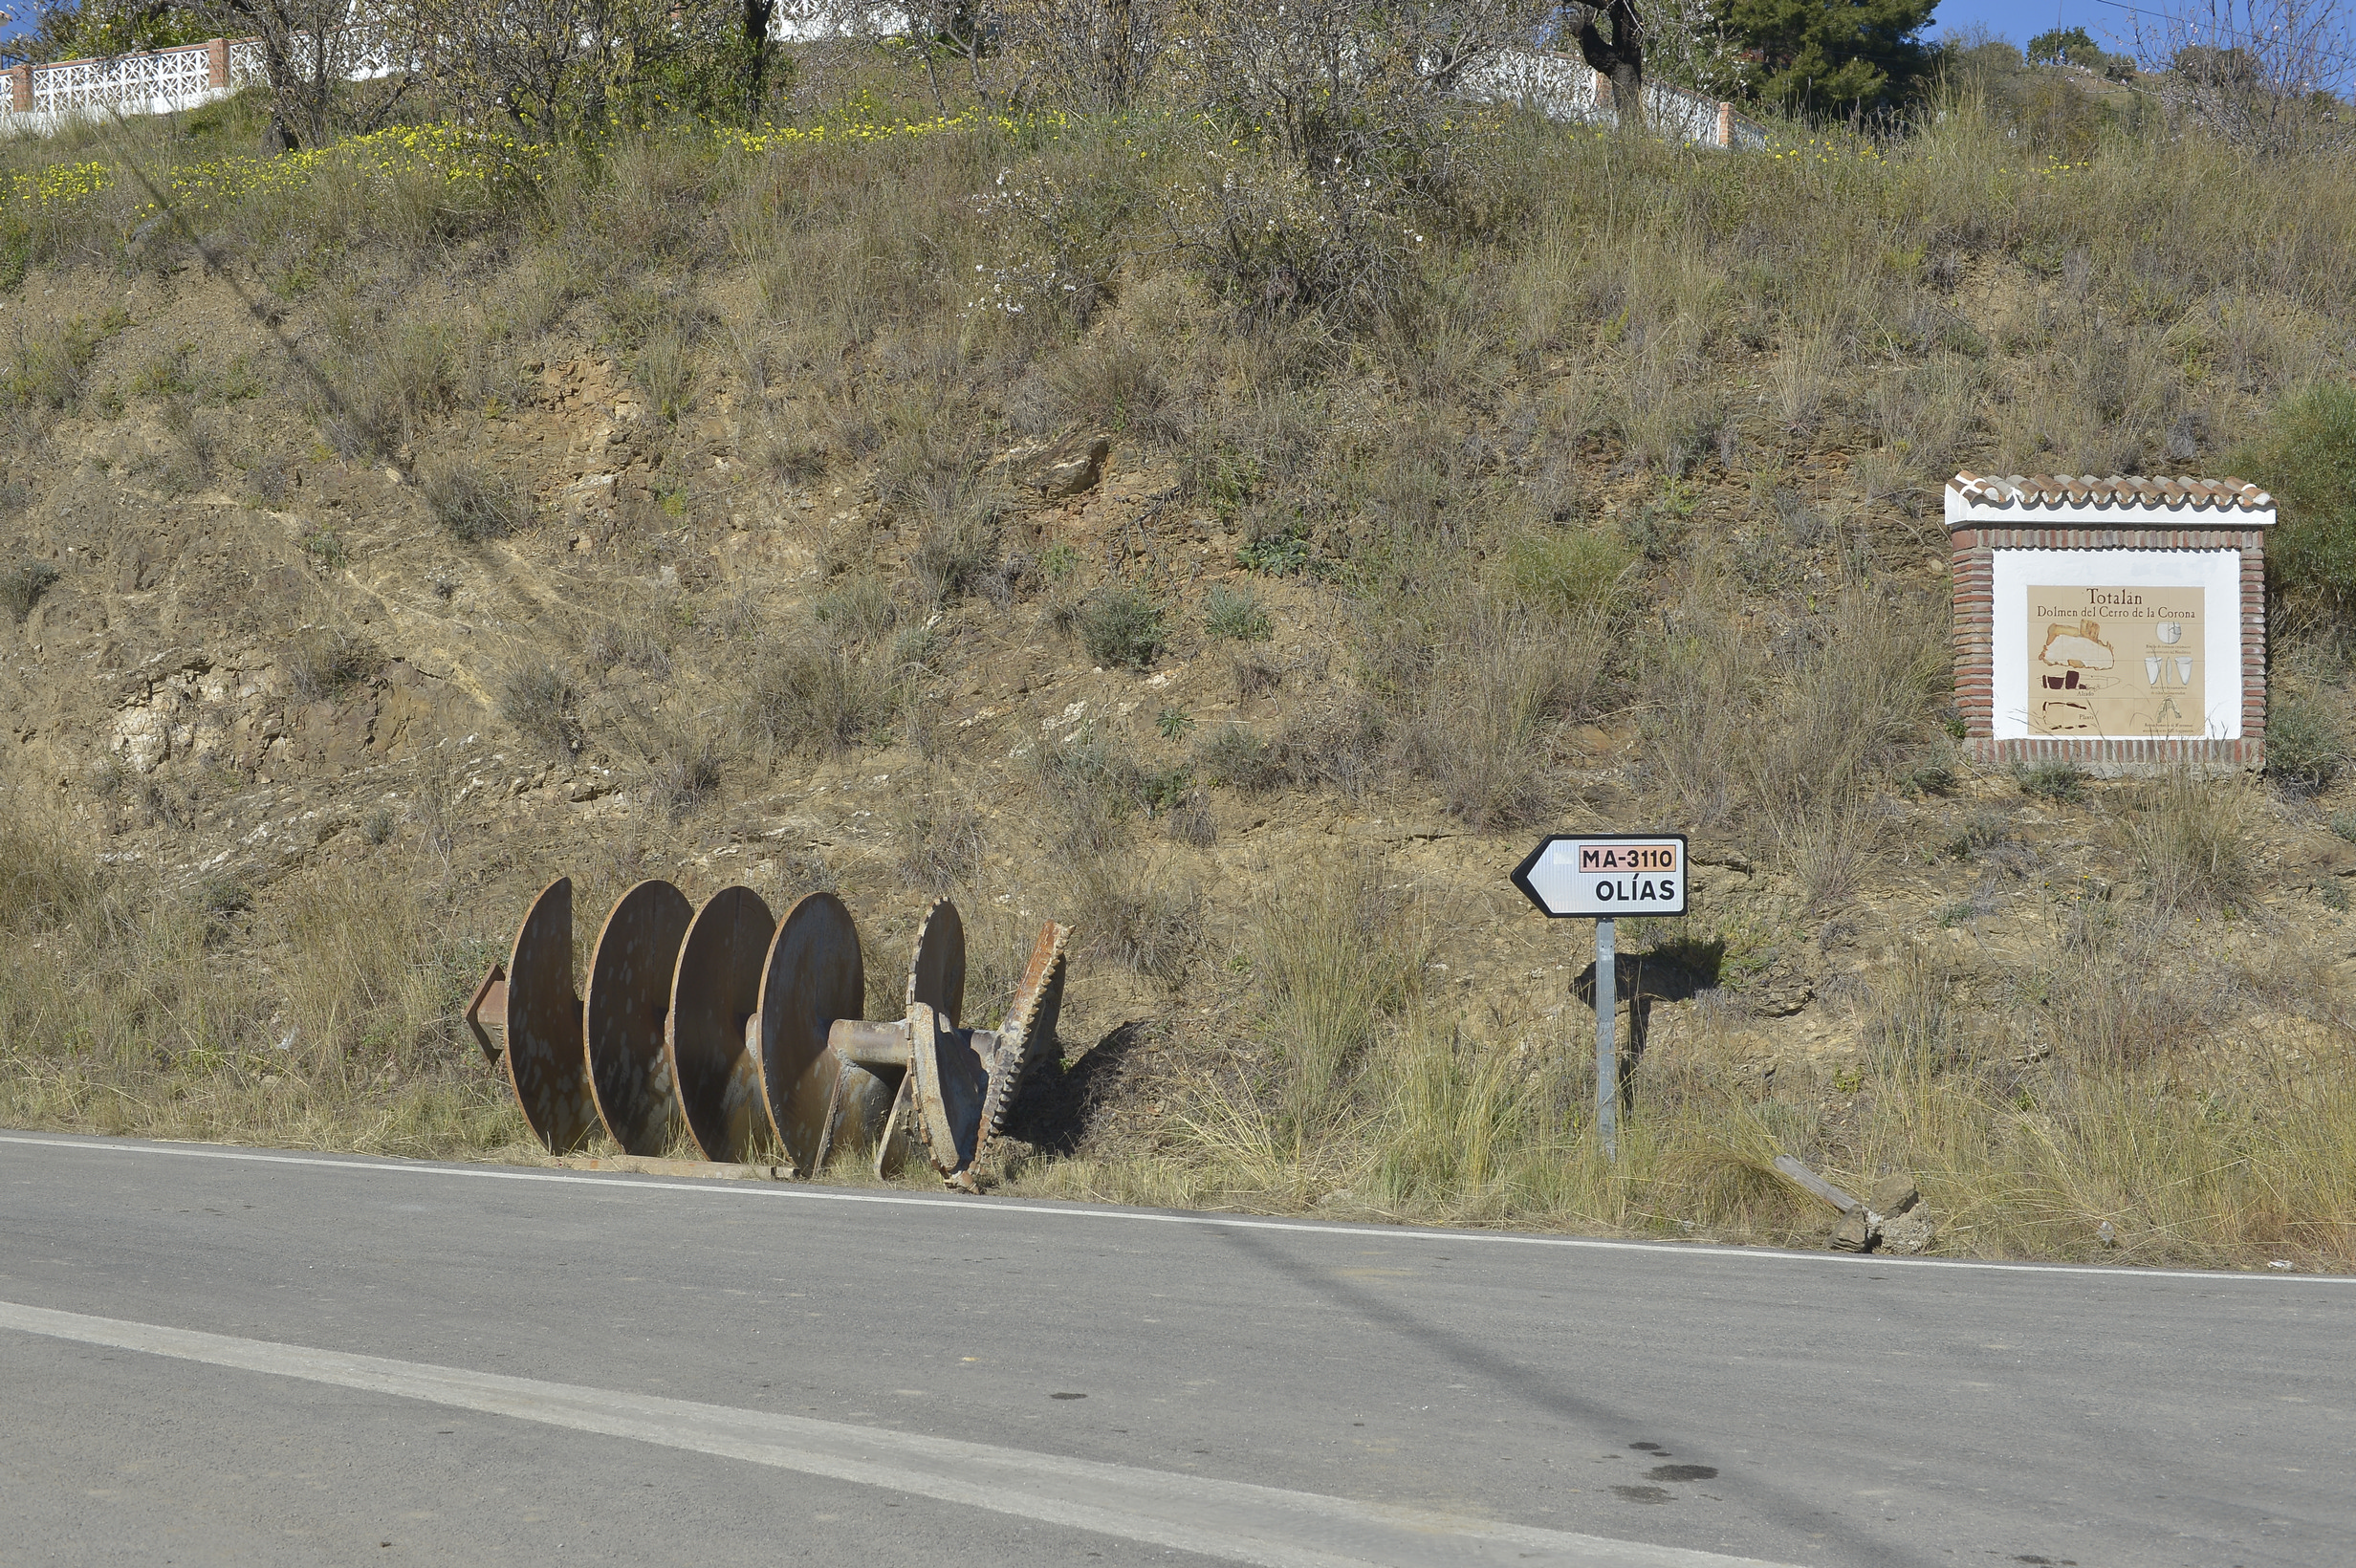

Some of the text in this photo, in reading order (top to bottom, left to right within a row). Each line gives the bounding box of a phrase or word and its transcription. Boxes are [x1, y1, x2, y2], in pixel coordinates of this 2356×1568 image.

[2086, 588, 2142, 605] Totalán
[2038, 606, 2195, 619] Dolmen del Cerro de la Corona
[1582, 850, 1672, 868] MA-3110
[1596, 873, 1675, 902] OLÍAS
